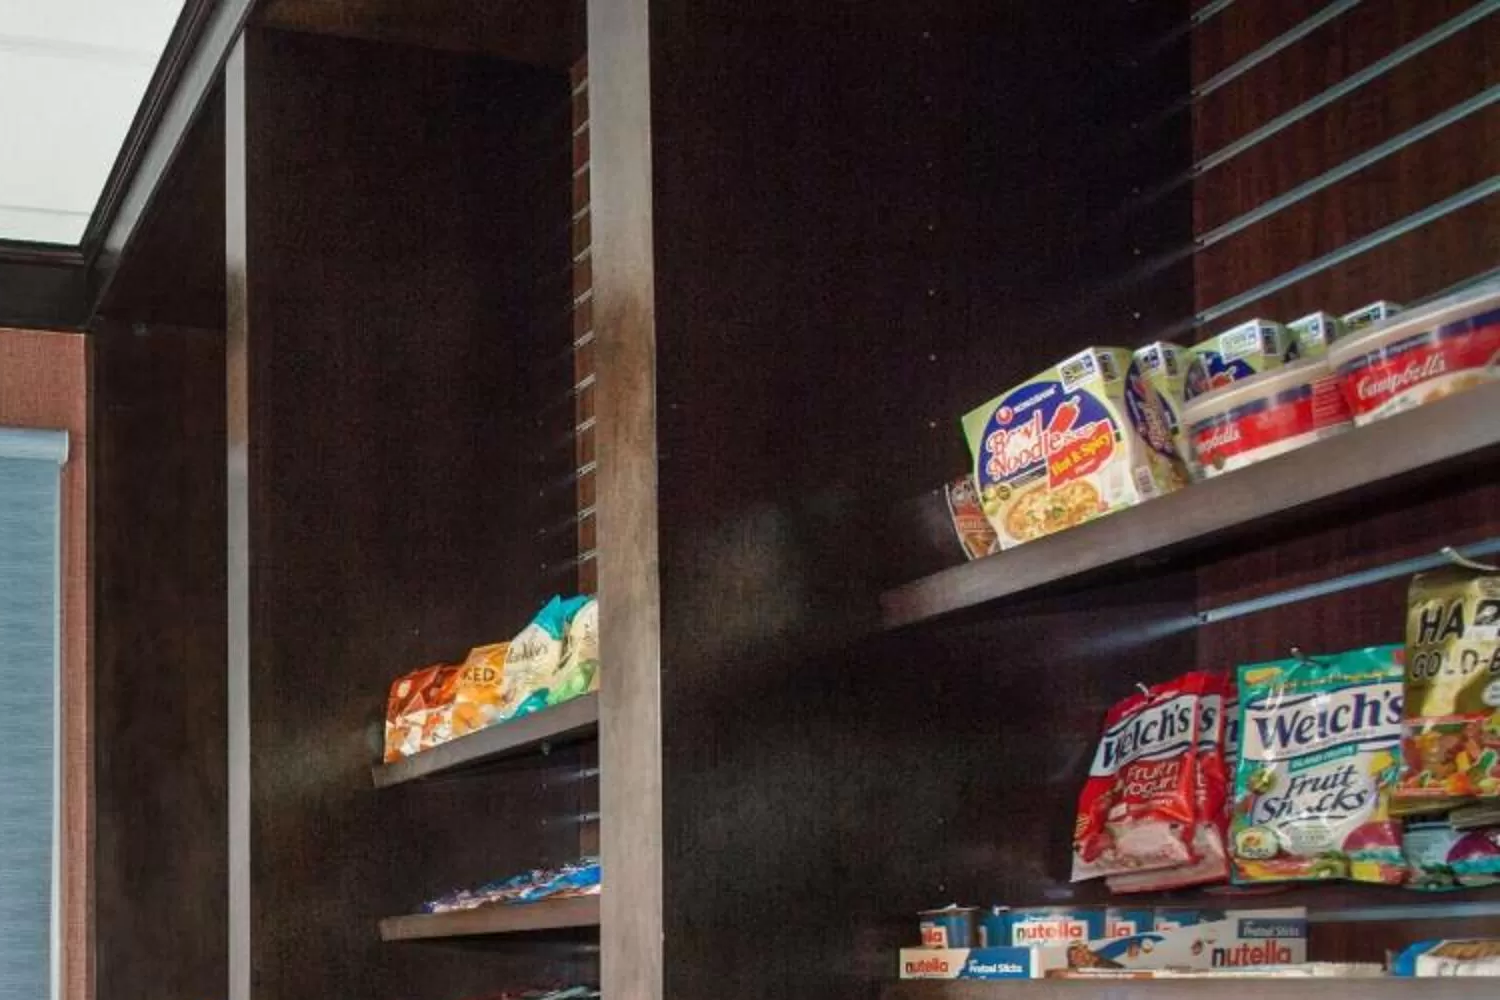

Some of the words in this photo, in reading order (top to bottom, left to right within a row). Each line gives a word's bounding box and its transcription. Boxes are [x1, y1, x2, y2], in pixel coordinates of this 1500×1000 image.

[1253, 690, 1403, 749] Welch's
[1103, 704, 1191, 769] Welch's
[1283, 764, 1359, 799] Fruit
[1017, 921, 1083, 939] nutella
[905, 958, 949, 974] nutella
[1211, 939, 1292, 969] nutella
